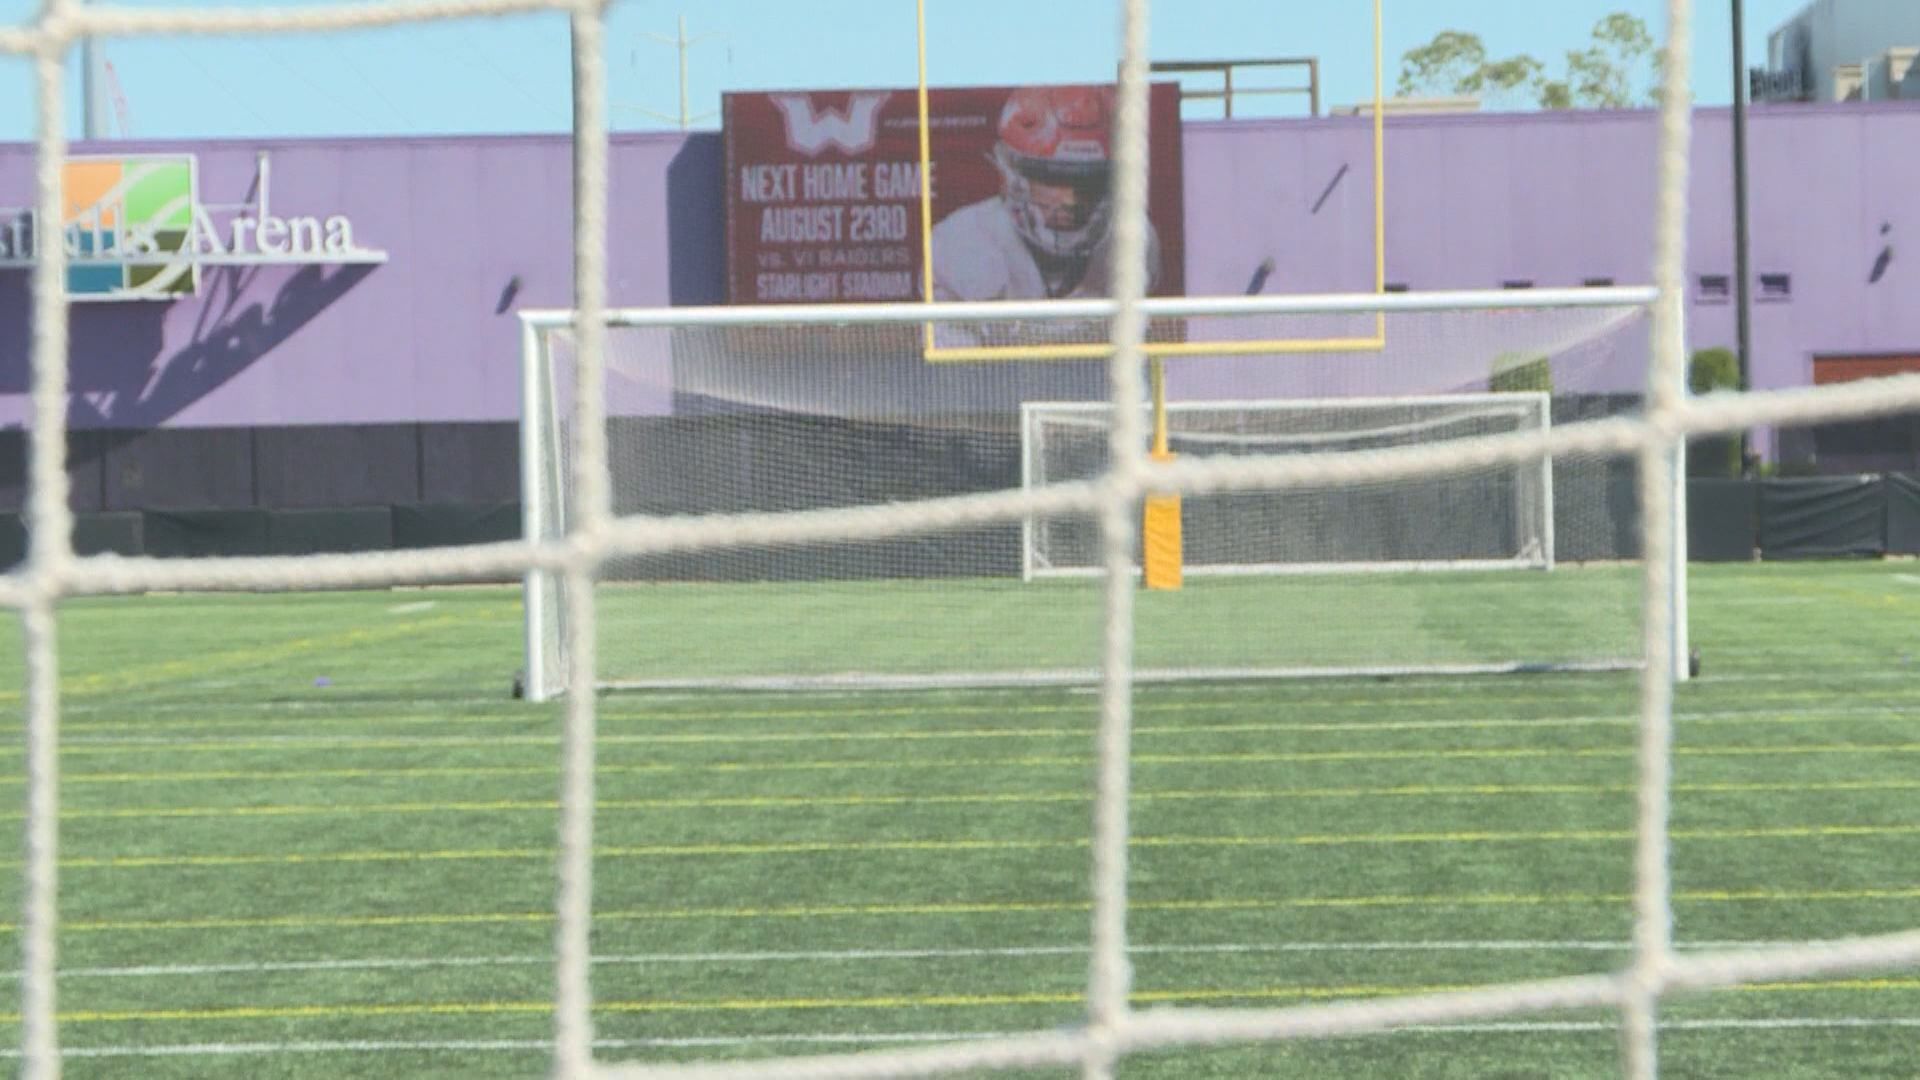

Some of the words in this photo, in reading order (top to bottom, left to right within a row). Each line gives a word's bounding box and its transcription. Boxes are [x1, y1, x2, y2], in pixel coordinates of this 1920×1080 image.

[741, 165, 797, 202] NEXT
[803, 164, 868, 199] HOME
[874, 163, 938, 198] GAME
[187, 208, 355, 256] Arena
[761, 206, 843, 242] AUGUST
[850, 206, 908, 240] 23RD
[818, 247, 911, 266] RAIDERS
[757, 273, 838, 300] STARLIGHT
[842, 271, 913, 298] STADIUM
